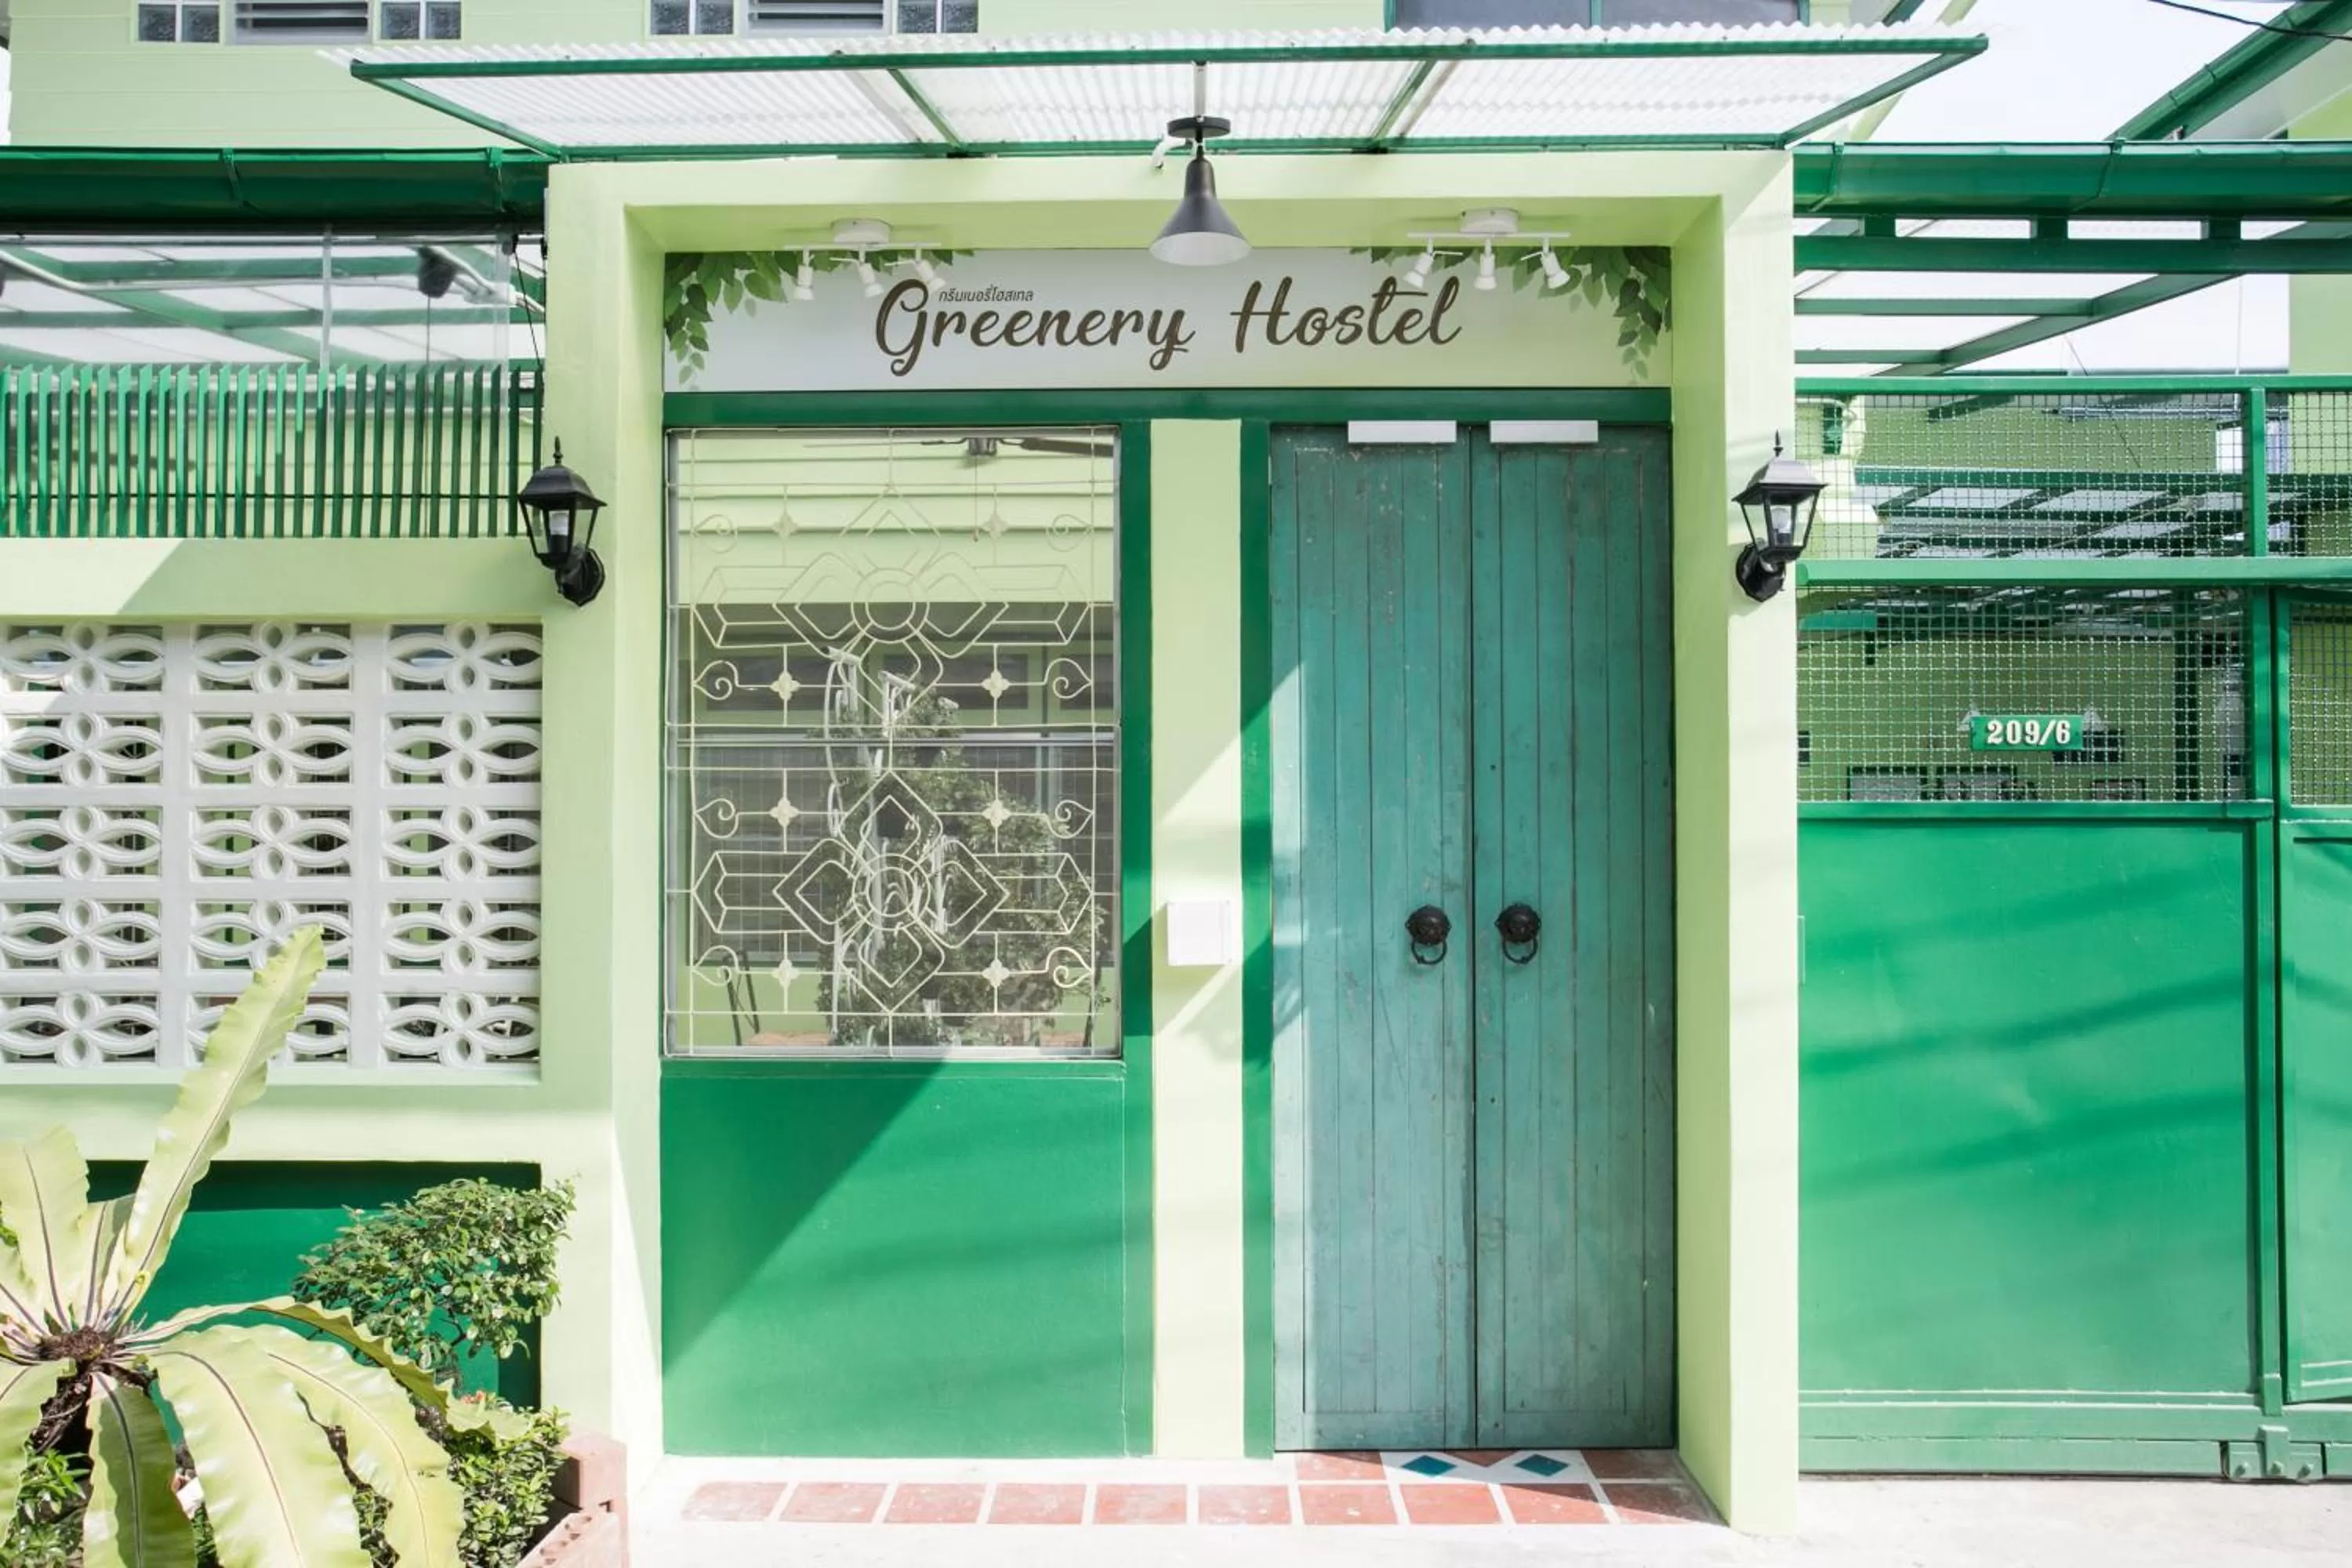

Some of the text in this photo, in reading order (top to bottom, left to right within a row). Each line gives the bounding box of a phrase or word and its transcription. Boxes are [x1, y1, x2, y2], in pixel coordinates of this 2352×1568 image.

[876, 275, 1462, 376] Greenery Hostel
[1987, 719, 2071, 746] 209/6
